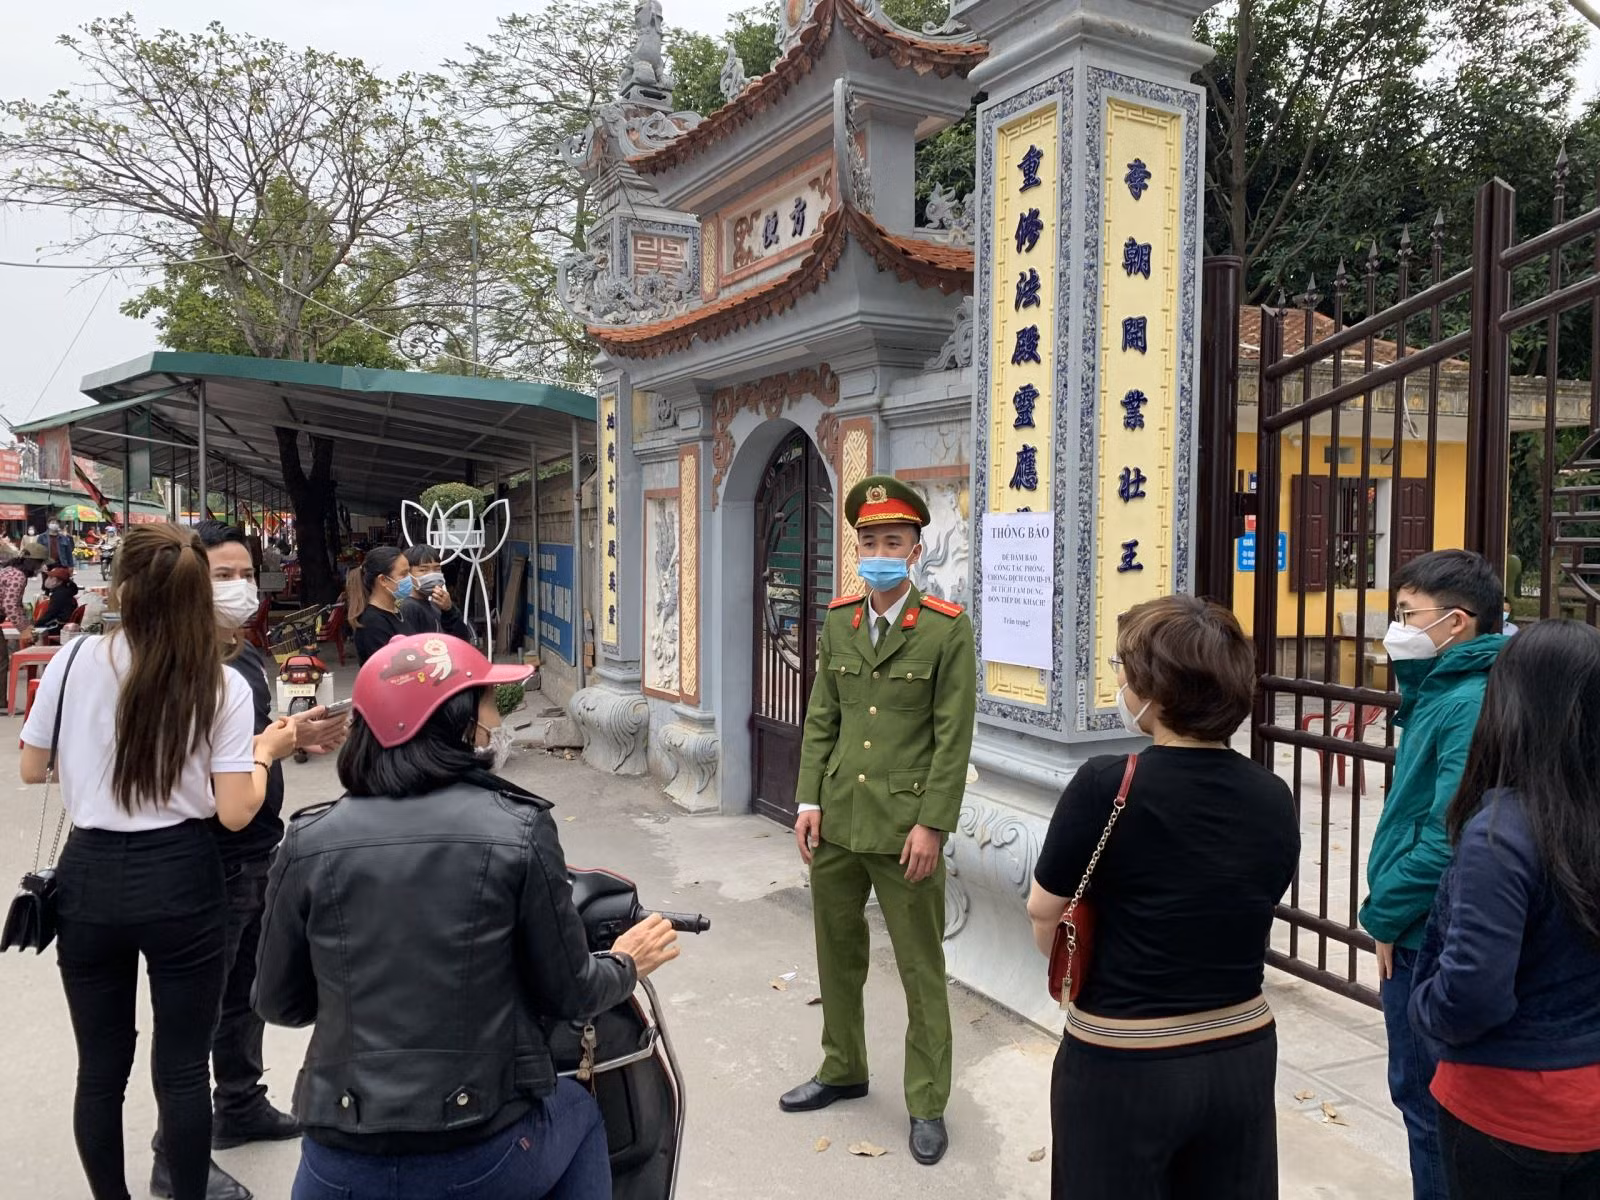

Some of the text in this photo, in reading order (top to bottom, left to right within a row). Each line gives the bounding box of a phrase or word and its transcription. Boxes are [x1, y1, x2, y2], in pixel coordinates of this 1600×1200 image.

[1009, 144, 1044, 512] 重修法殿靈應
[990, 523, 1050, 539] THÔNG BÁO
[993, 563, 1011, 571] CÔNG
